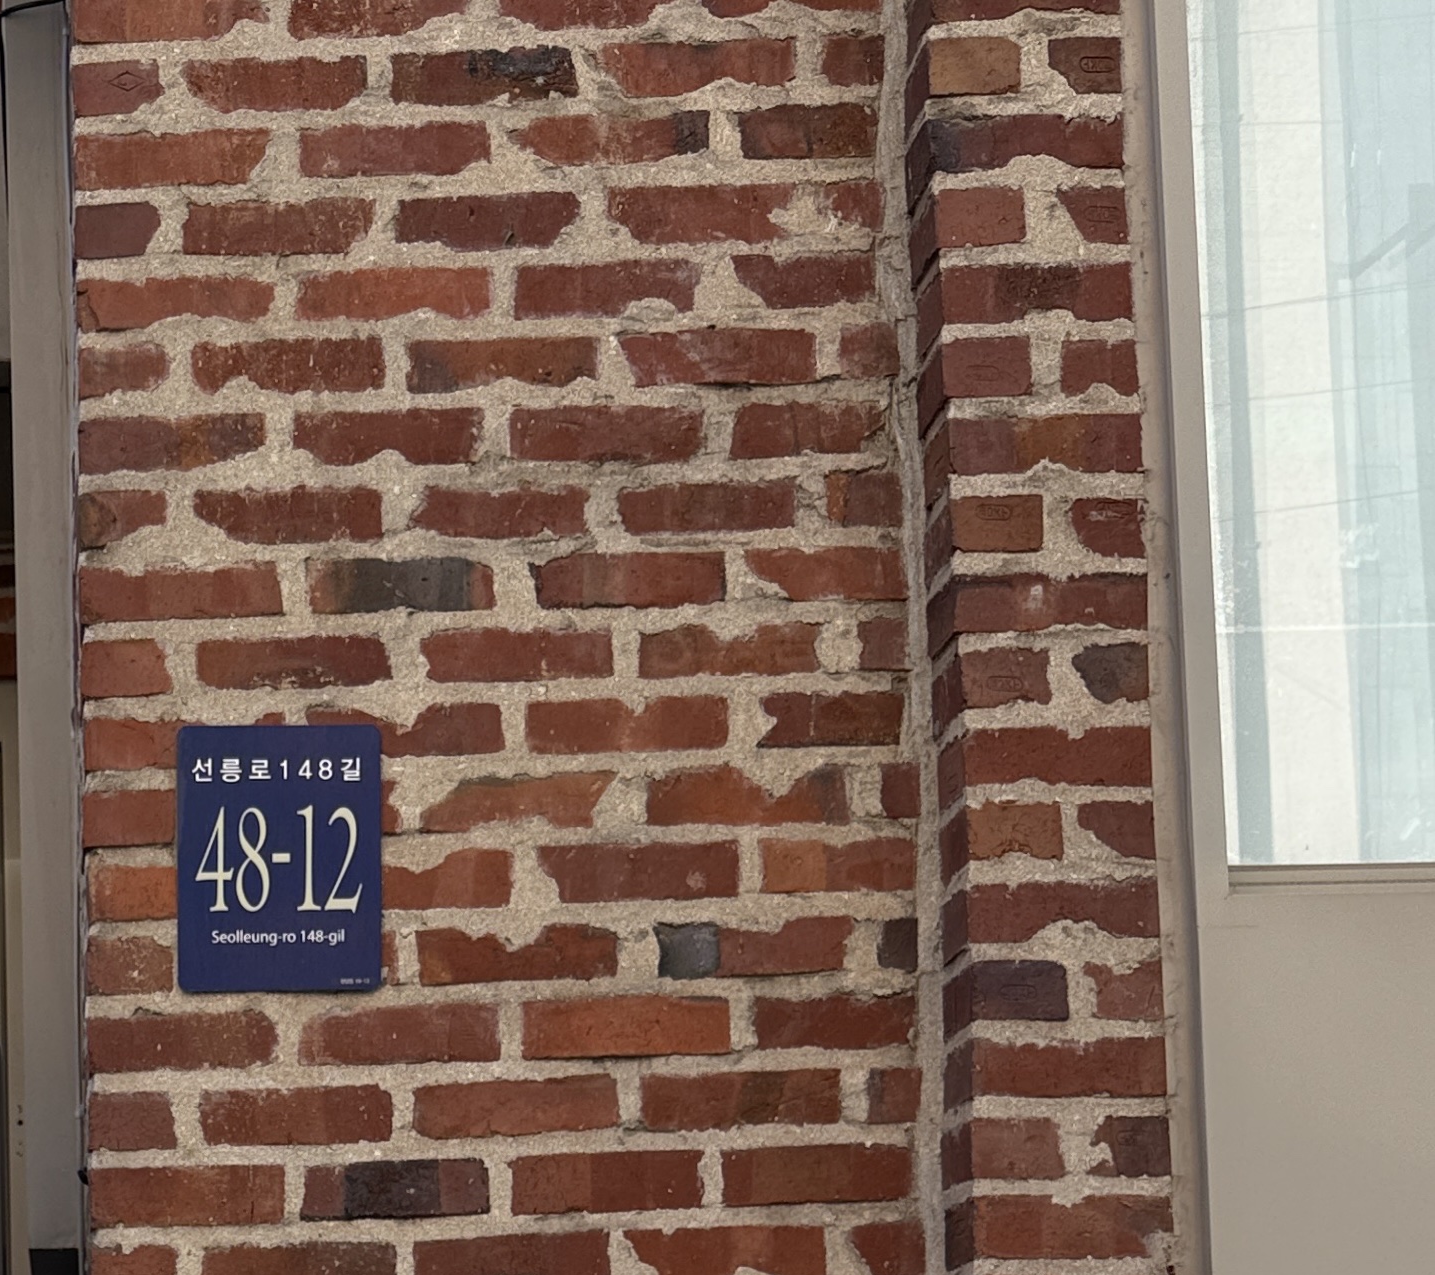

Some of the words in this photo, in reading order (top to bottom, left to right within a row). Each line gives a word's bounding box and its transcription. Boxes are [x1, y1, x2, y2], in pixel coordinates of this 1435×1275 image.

[191, 757, 362, 783] 선릉로148길
[195, 804, 363, 914] 48-12
[211, 929, 297, 946] Seolleung-ro
[300, 929, 346, 946] 148-gil
